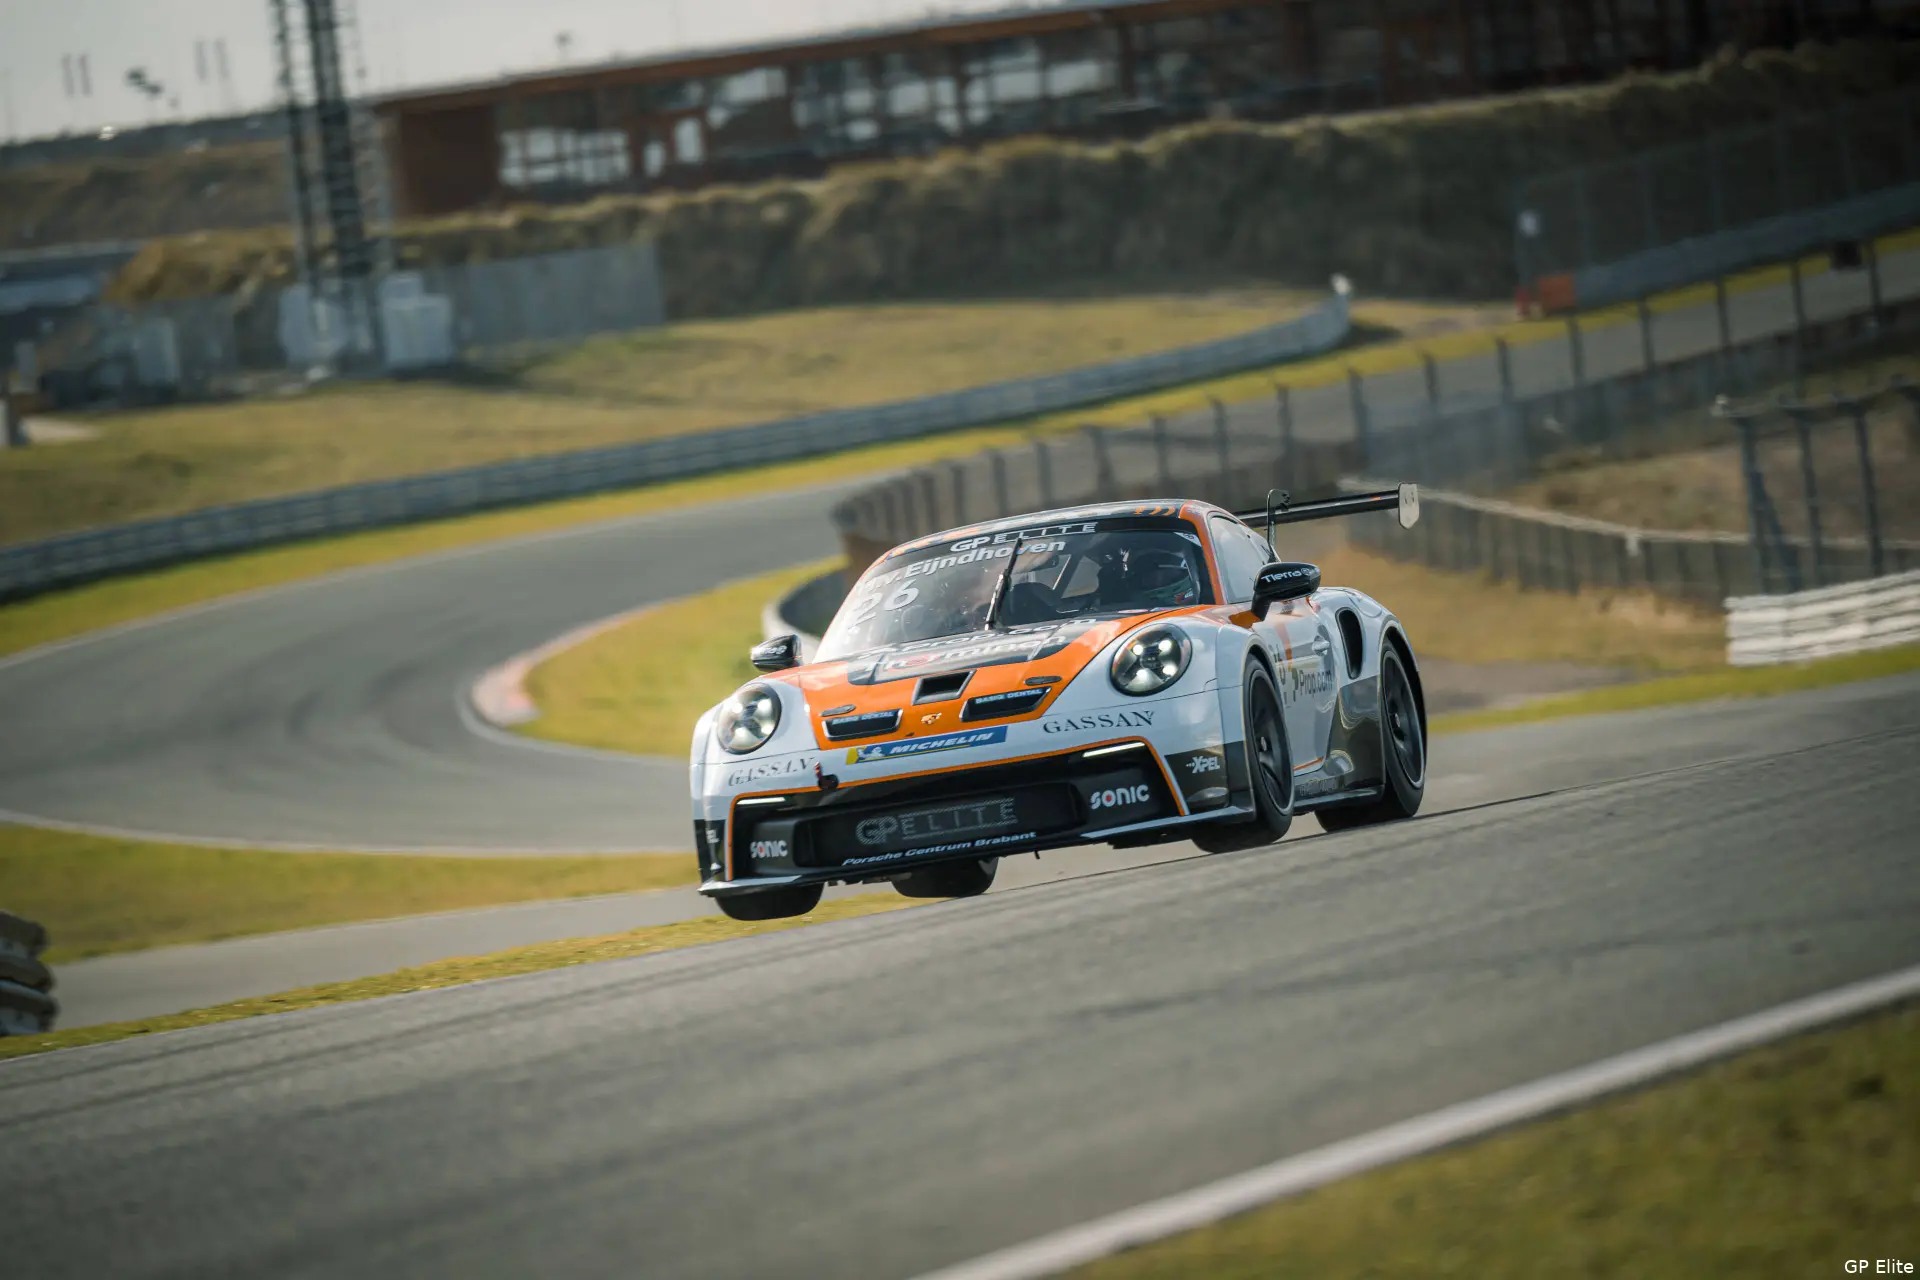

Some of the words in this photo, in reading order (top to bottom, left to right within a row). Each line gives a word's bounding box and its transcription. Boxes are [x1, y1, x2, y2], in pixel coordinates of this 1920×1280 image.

[849, 578, 919, 629] 26
[1043, 710, 1155, 734] GASSAN
[889, 732, 995, 754] MICHELIN
[728, 757, 815, 787] GASSAN
[1191, 755, 1220, 774] XPEL
[842, 851, 902, 867] Porsche
[904, 841, 972, 858] Centrum
[974, 831, 1037, 848] Brabant
